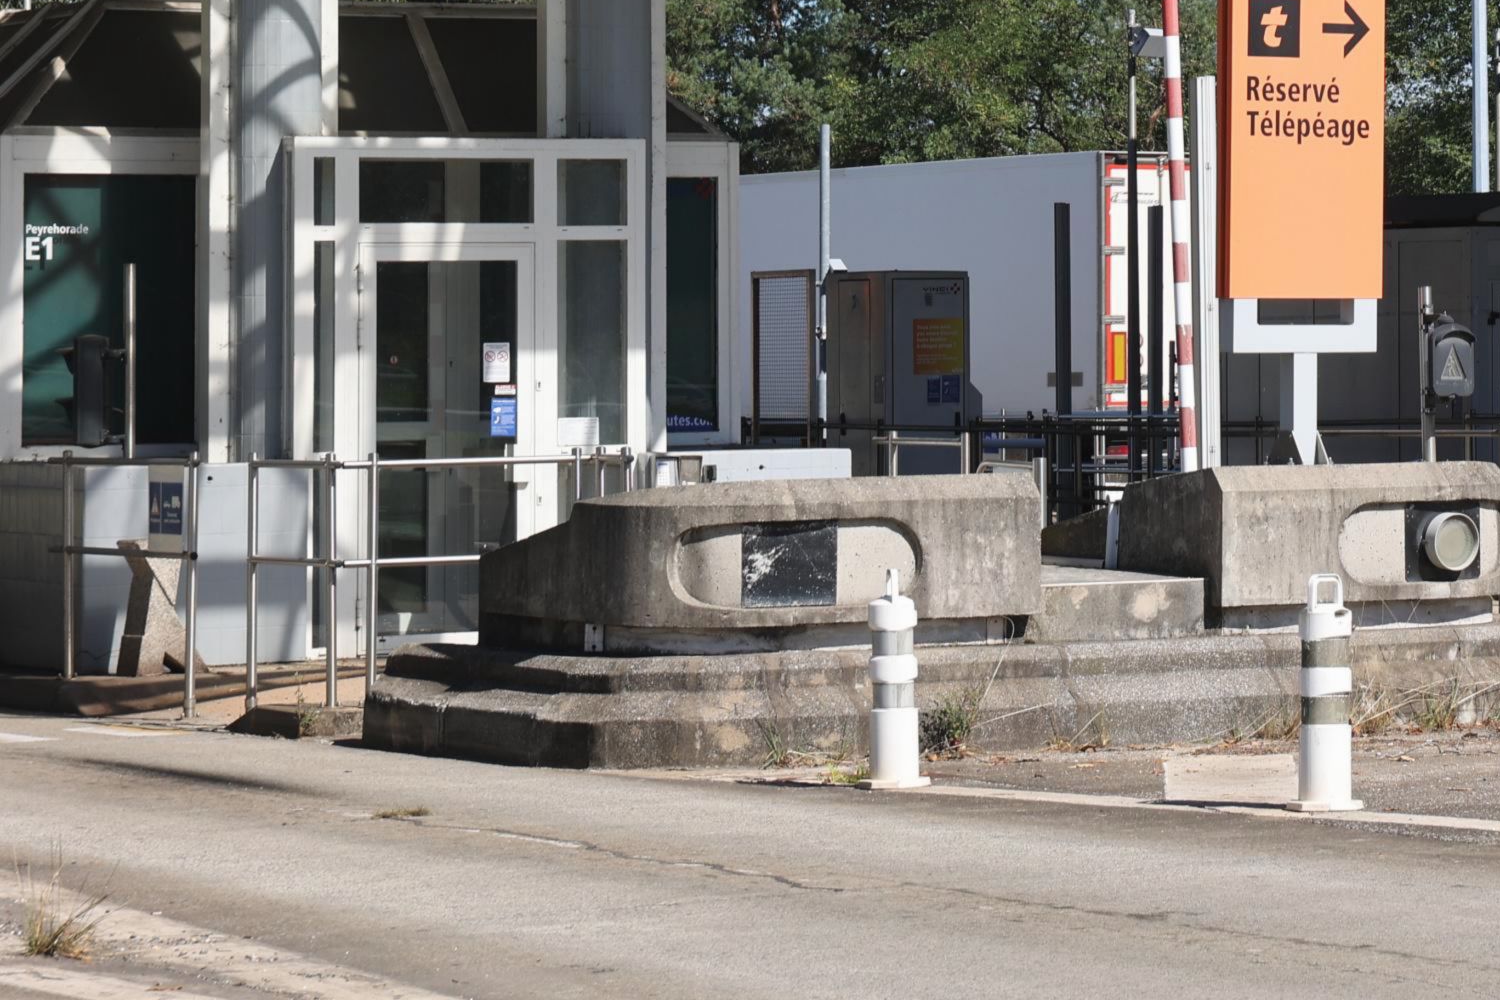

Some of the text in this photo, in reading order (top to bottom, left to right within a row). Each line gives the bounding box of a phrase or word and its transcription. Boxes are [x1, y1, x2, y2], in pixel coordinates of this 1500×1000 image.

[1246, 75, 1340, 103] Réservé
[1246, 109, 1370, 146] Télépéage
[25, 222, 89, 237] Peyrehorade
[25, 236, 53, 261] E1
